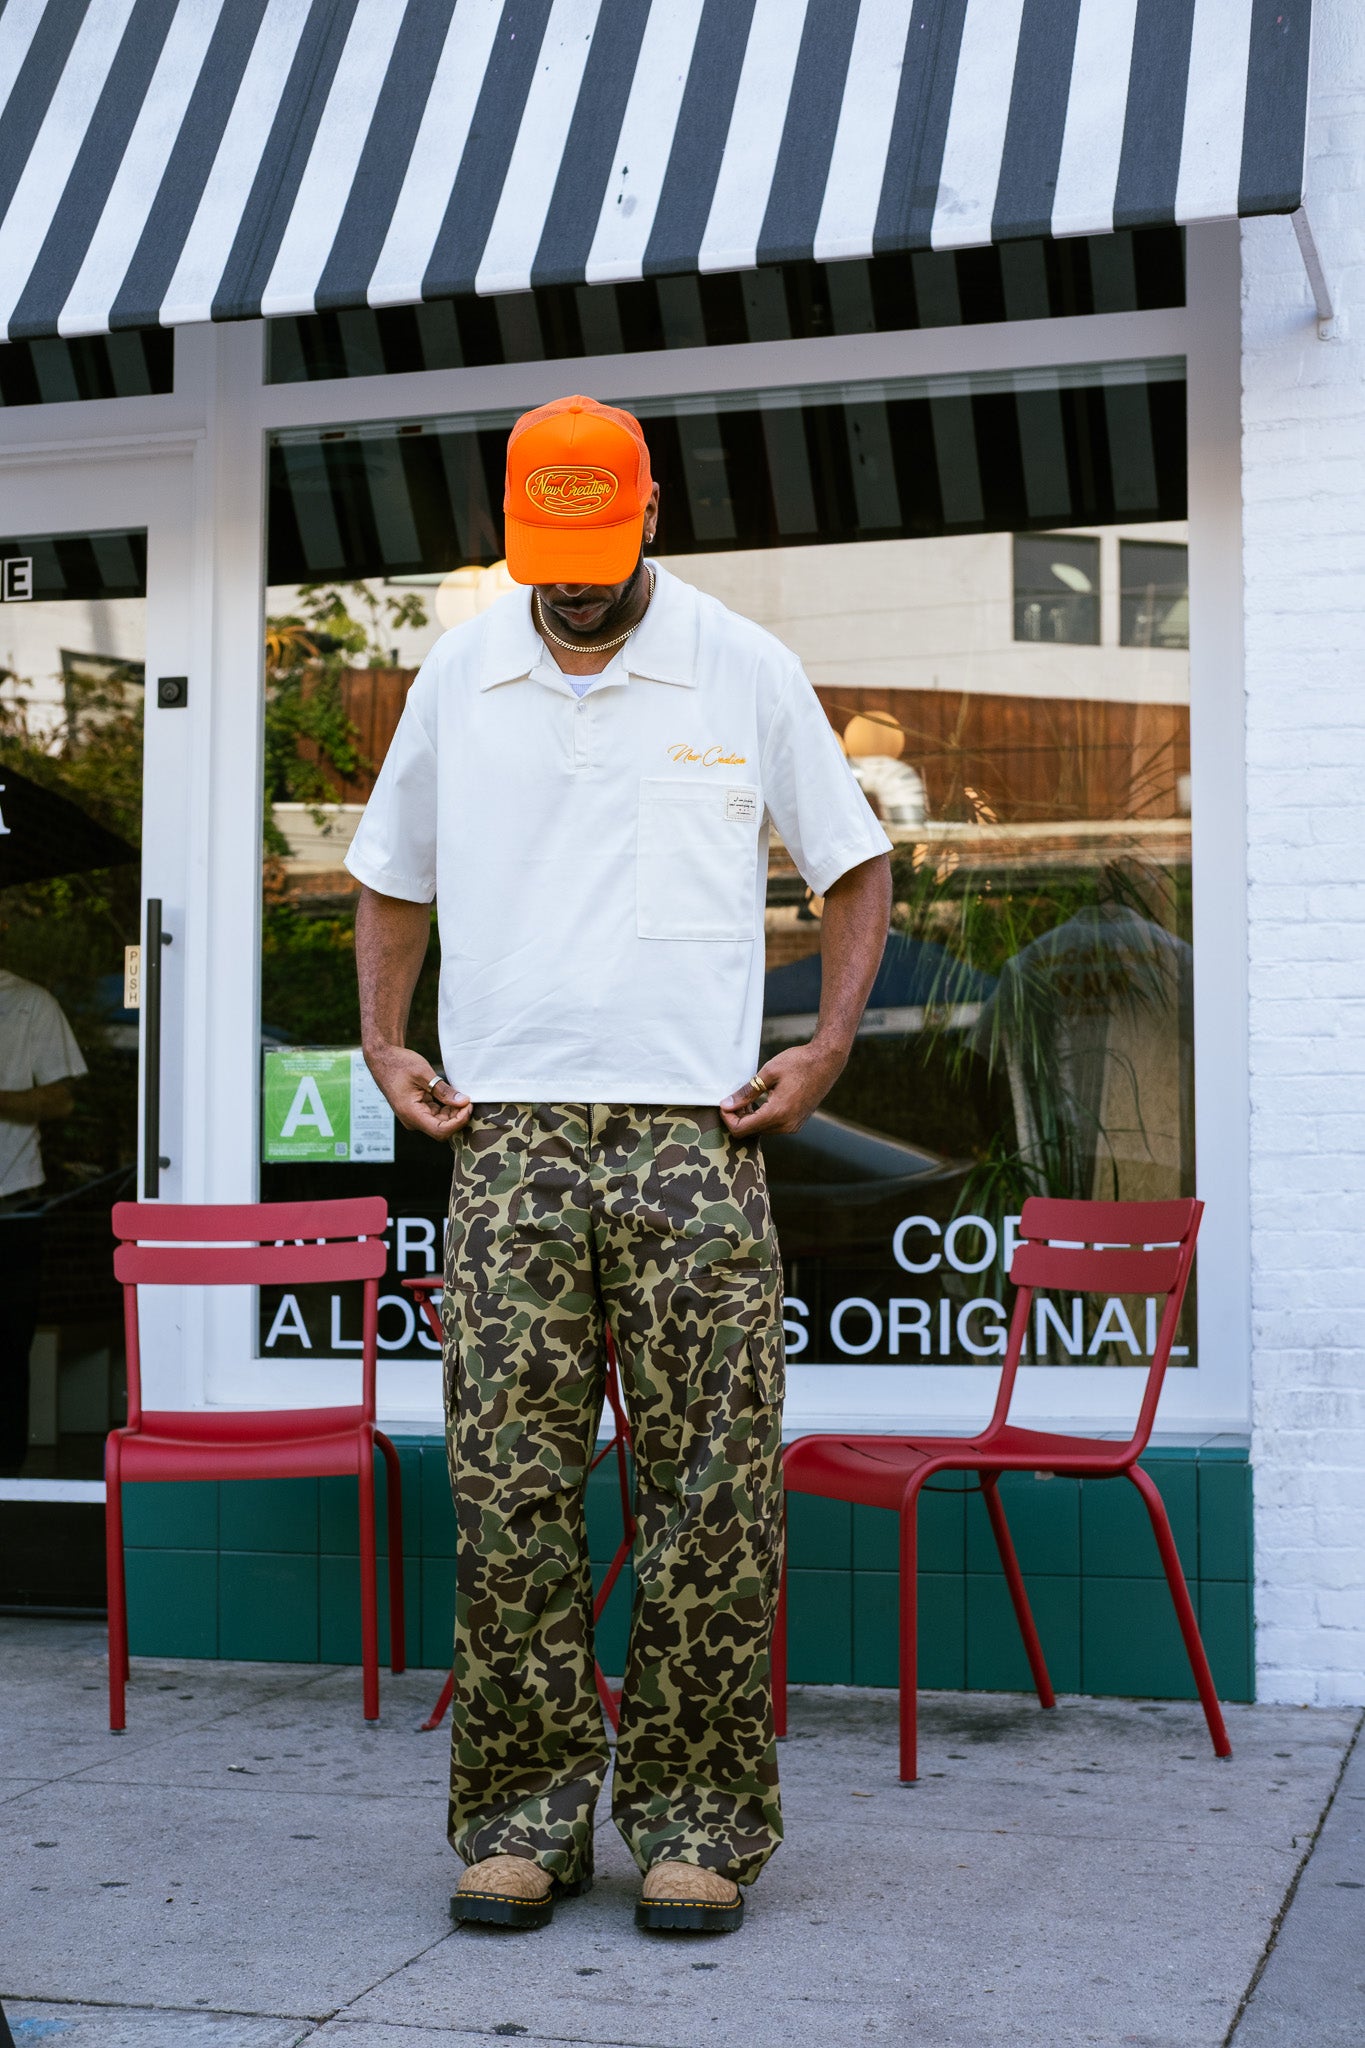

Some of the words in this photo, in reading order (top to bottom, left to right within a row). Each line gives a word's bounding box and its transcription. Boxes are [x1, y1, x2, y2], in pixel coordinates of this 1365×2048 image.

[531, 473, 562, 496] New
[560, 472, 611, 498] Creation
[667, 743, 701, 764] New
[129, 951, 138, 1003] PUSH
[280, 1076, 334, 1137] A
[264, 1294, 312, 1349] A
[830, 1297, 1189, 1356] ORIGNAL
